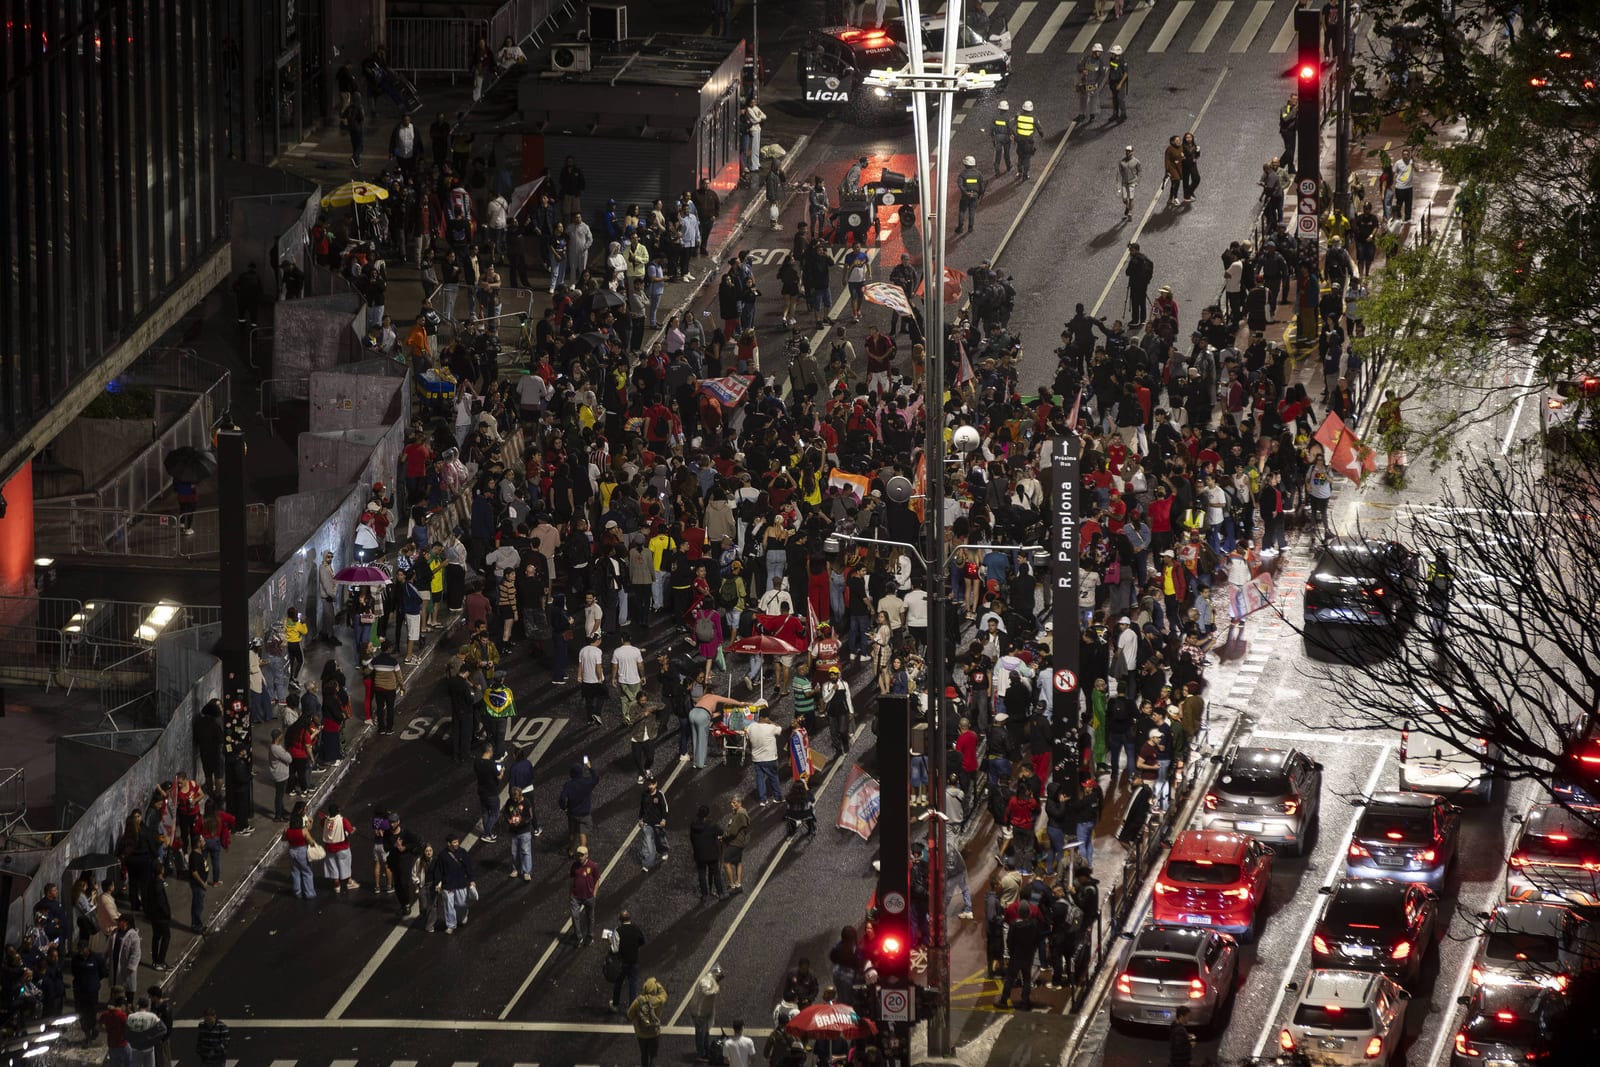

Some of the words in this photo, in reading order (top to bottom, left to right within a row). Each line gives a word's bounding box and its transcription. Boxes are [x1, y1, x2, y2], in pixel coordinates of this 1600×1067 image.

[1302, 182, 1314, 191] 50
[1058, 481, 1075, 562] Pamplona
[1058, 571, 1072, 588] R.
[888, 996, 903, 1005] 20
[814, 1013, 853, 1028] BRAHM
